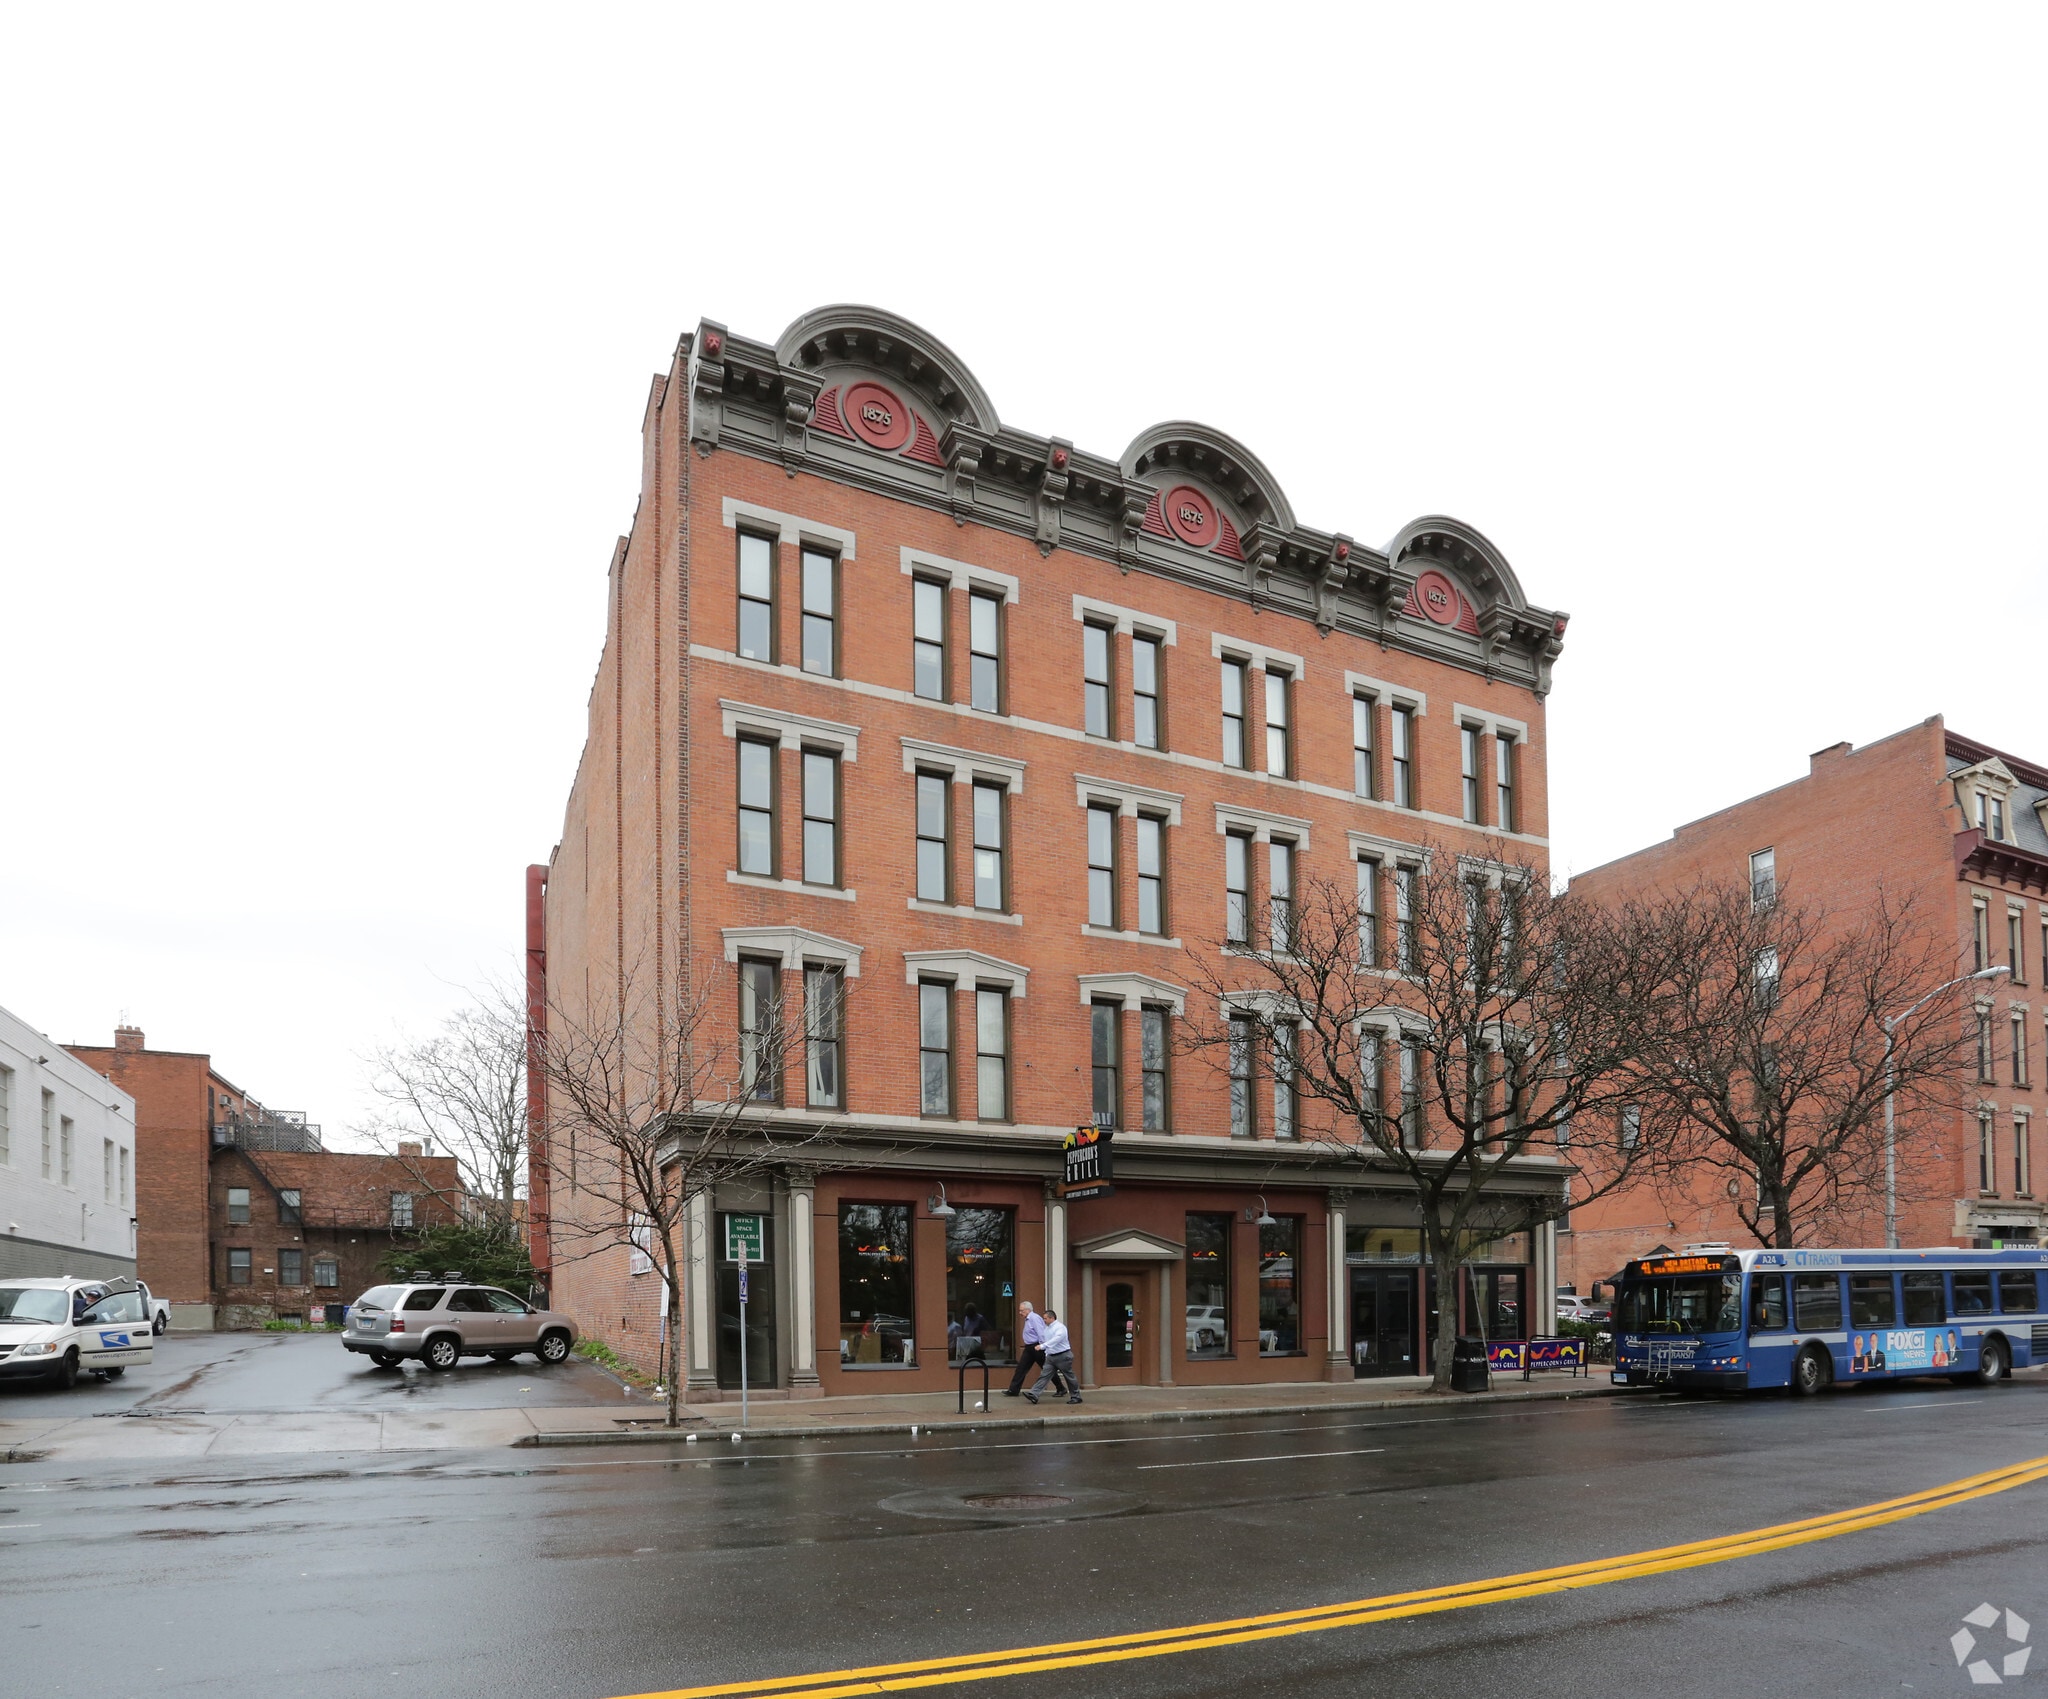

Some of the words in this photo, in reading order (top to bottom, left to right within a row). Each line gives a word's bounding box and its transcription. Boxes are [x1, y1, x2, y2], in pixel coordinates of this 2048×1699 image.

[863, 405, 892, 426] 1875
[1180, 507, 1203, 525] 1875
[1428, 591, 1447, 606] 1875
[1067, 1145, 1098, 1164] PEPPERCORN'S
[1066, 1160, 1100, 1182] GRILL
[1762, 1256, 1777, 1264] A24
[1809, 1254, 1840, 1265] TRANSIT
[1641, 1262, 1652, 1275] 41
[1004, 1284, 1012, 1292] A
[1903, 1350, 1926, 1358] NEWS
